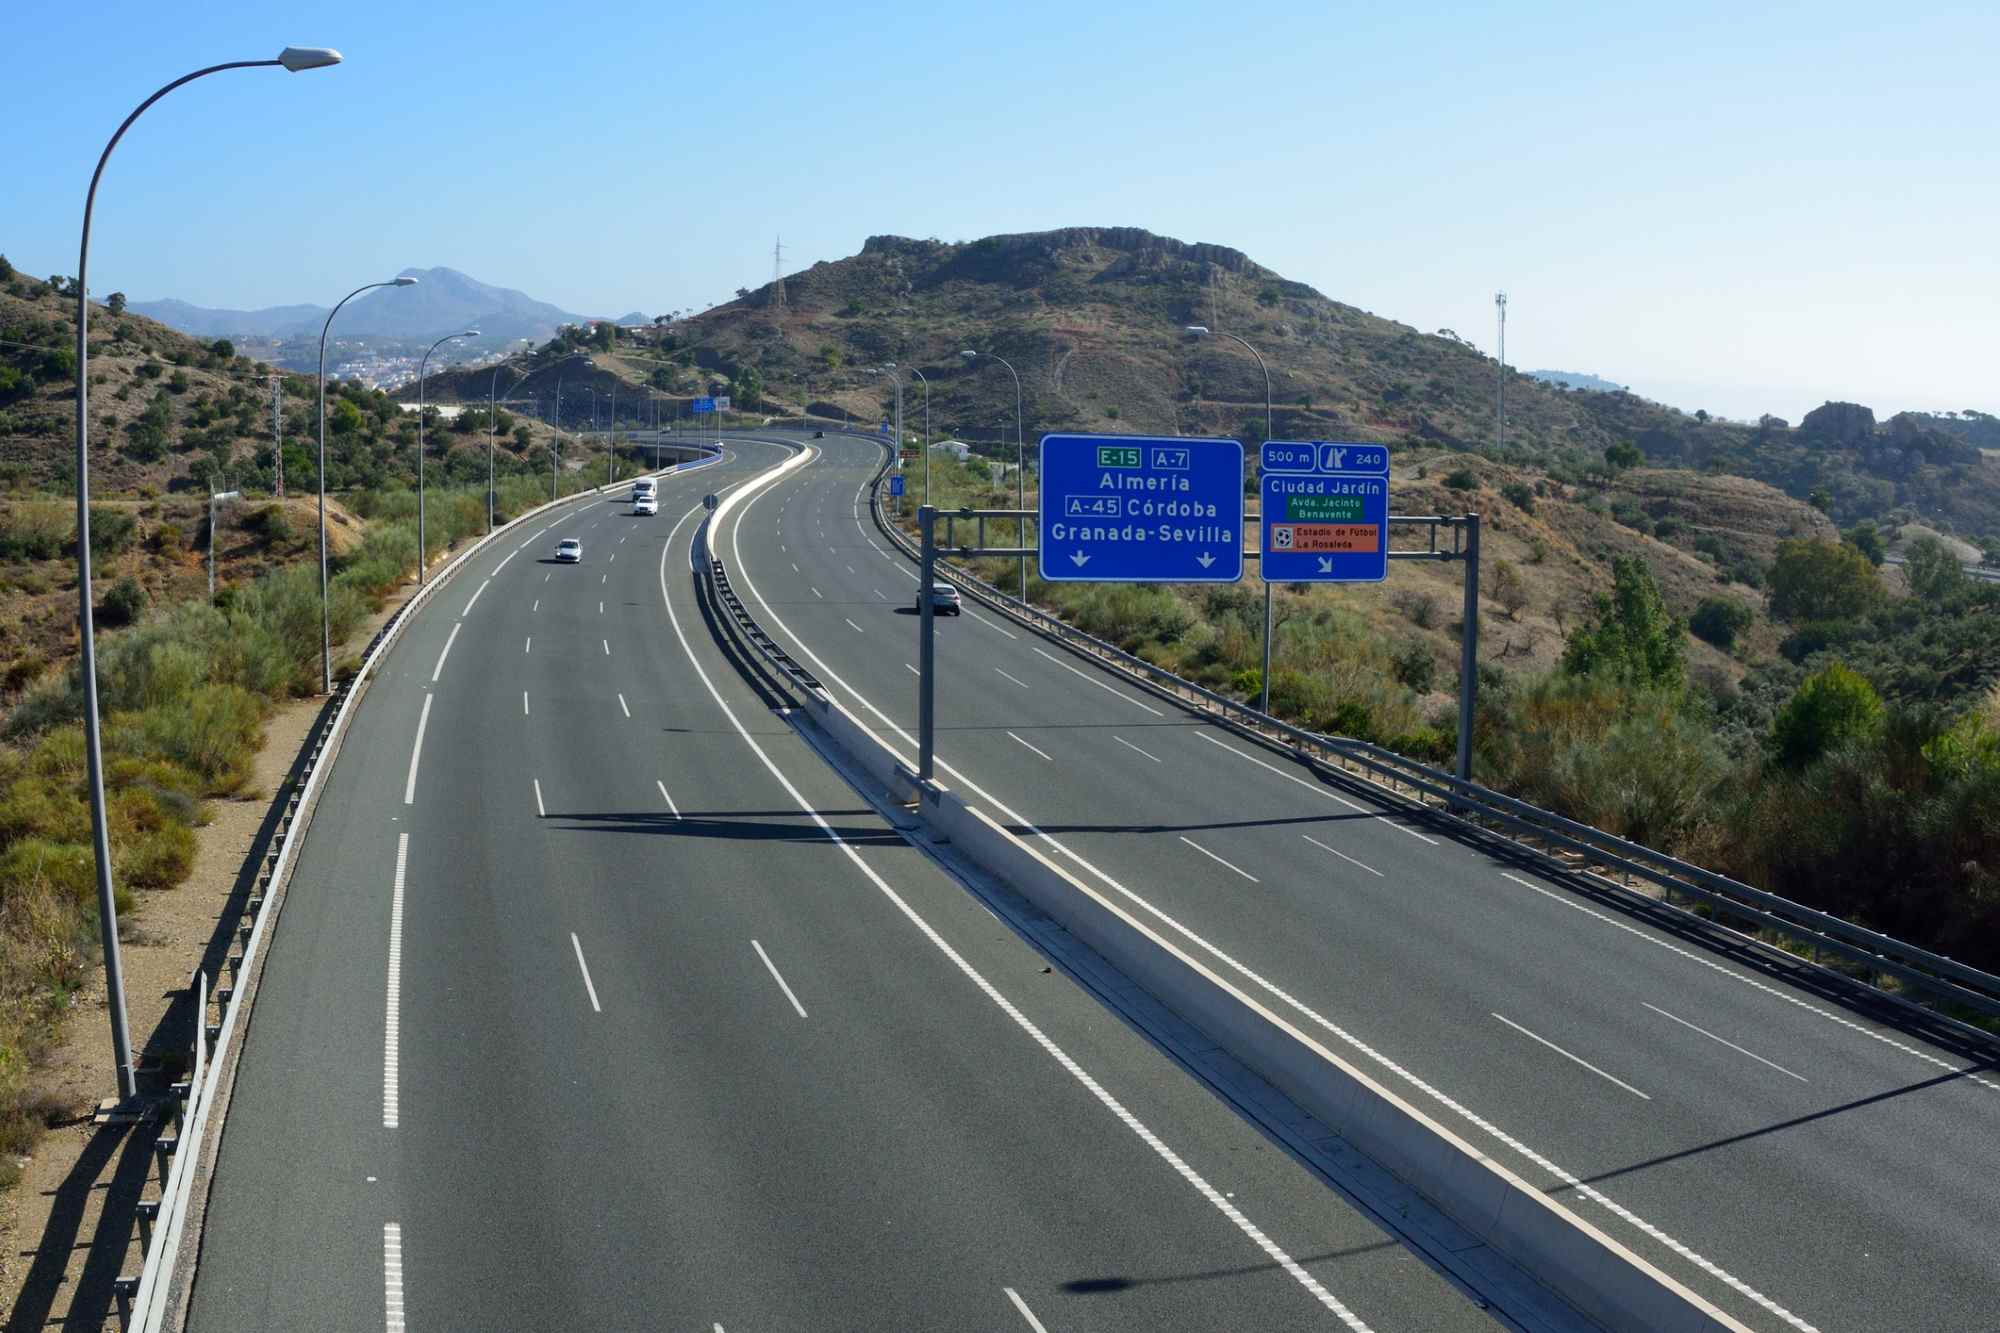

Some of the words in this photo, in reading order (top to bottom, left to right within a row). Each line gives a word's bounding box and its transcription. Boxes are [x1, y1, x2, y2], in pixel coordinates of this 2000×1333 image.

[1101, 451, 1138, 465] E-15
[1156, 453, 1186, 466] A-7
[1269, 451, 1294, 462] 500
[1300, 454, 1310, 462] m
[1100, 472, 1190, 492] Almería
[1272, 481, 1324, 494] Ciudad
[1332, 482, 1380, 495] Jardín
[1070, 501, 1117, 513] A-45
[1128, 500, 1217, 517] Córdoba
[1292, 498, 1319, 507] Avda.
[1323, 499, 1360, 508] Jacinto
[1299, 510, 1352, 519] Benavente
[1052, 524, 1232, 543] Granada-Sevilla
[1297, 528, 1331, 536] Estadio
[1336, 528, 1346, 536] de
[1297, 541, 1309, 549] La
[1312, 540, 1352, 549] Rosaleda
